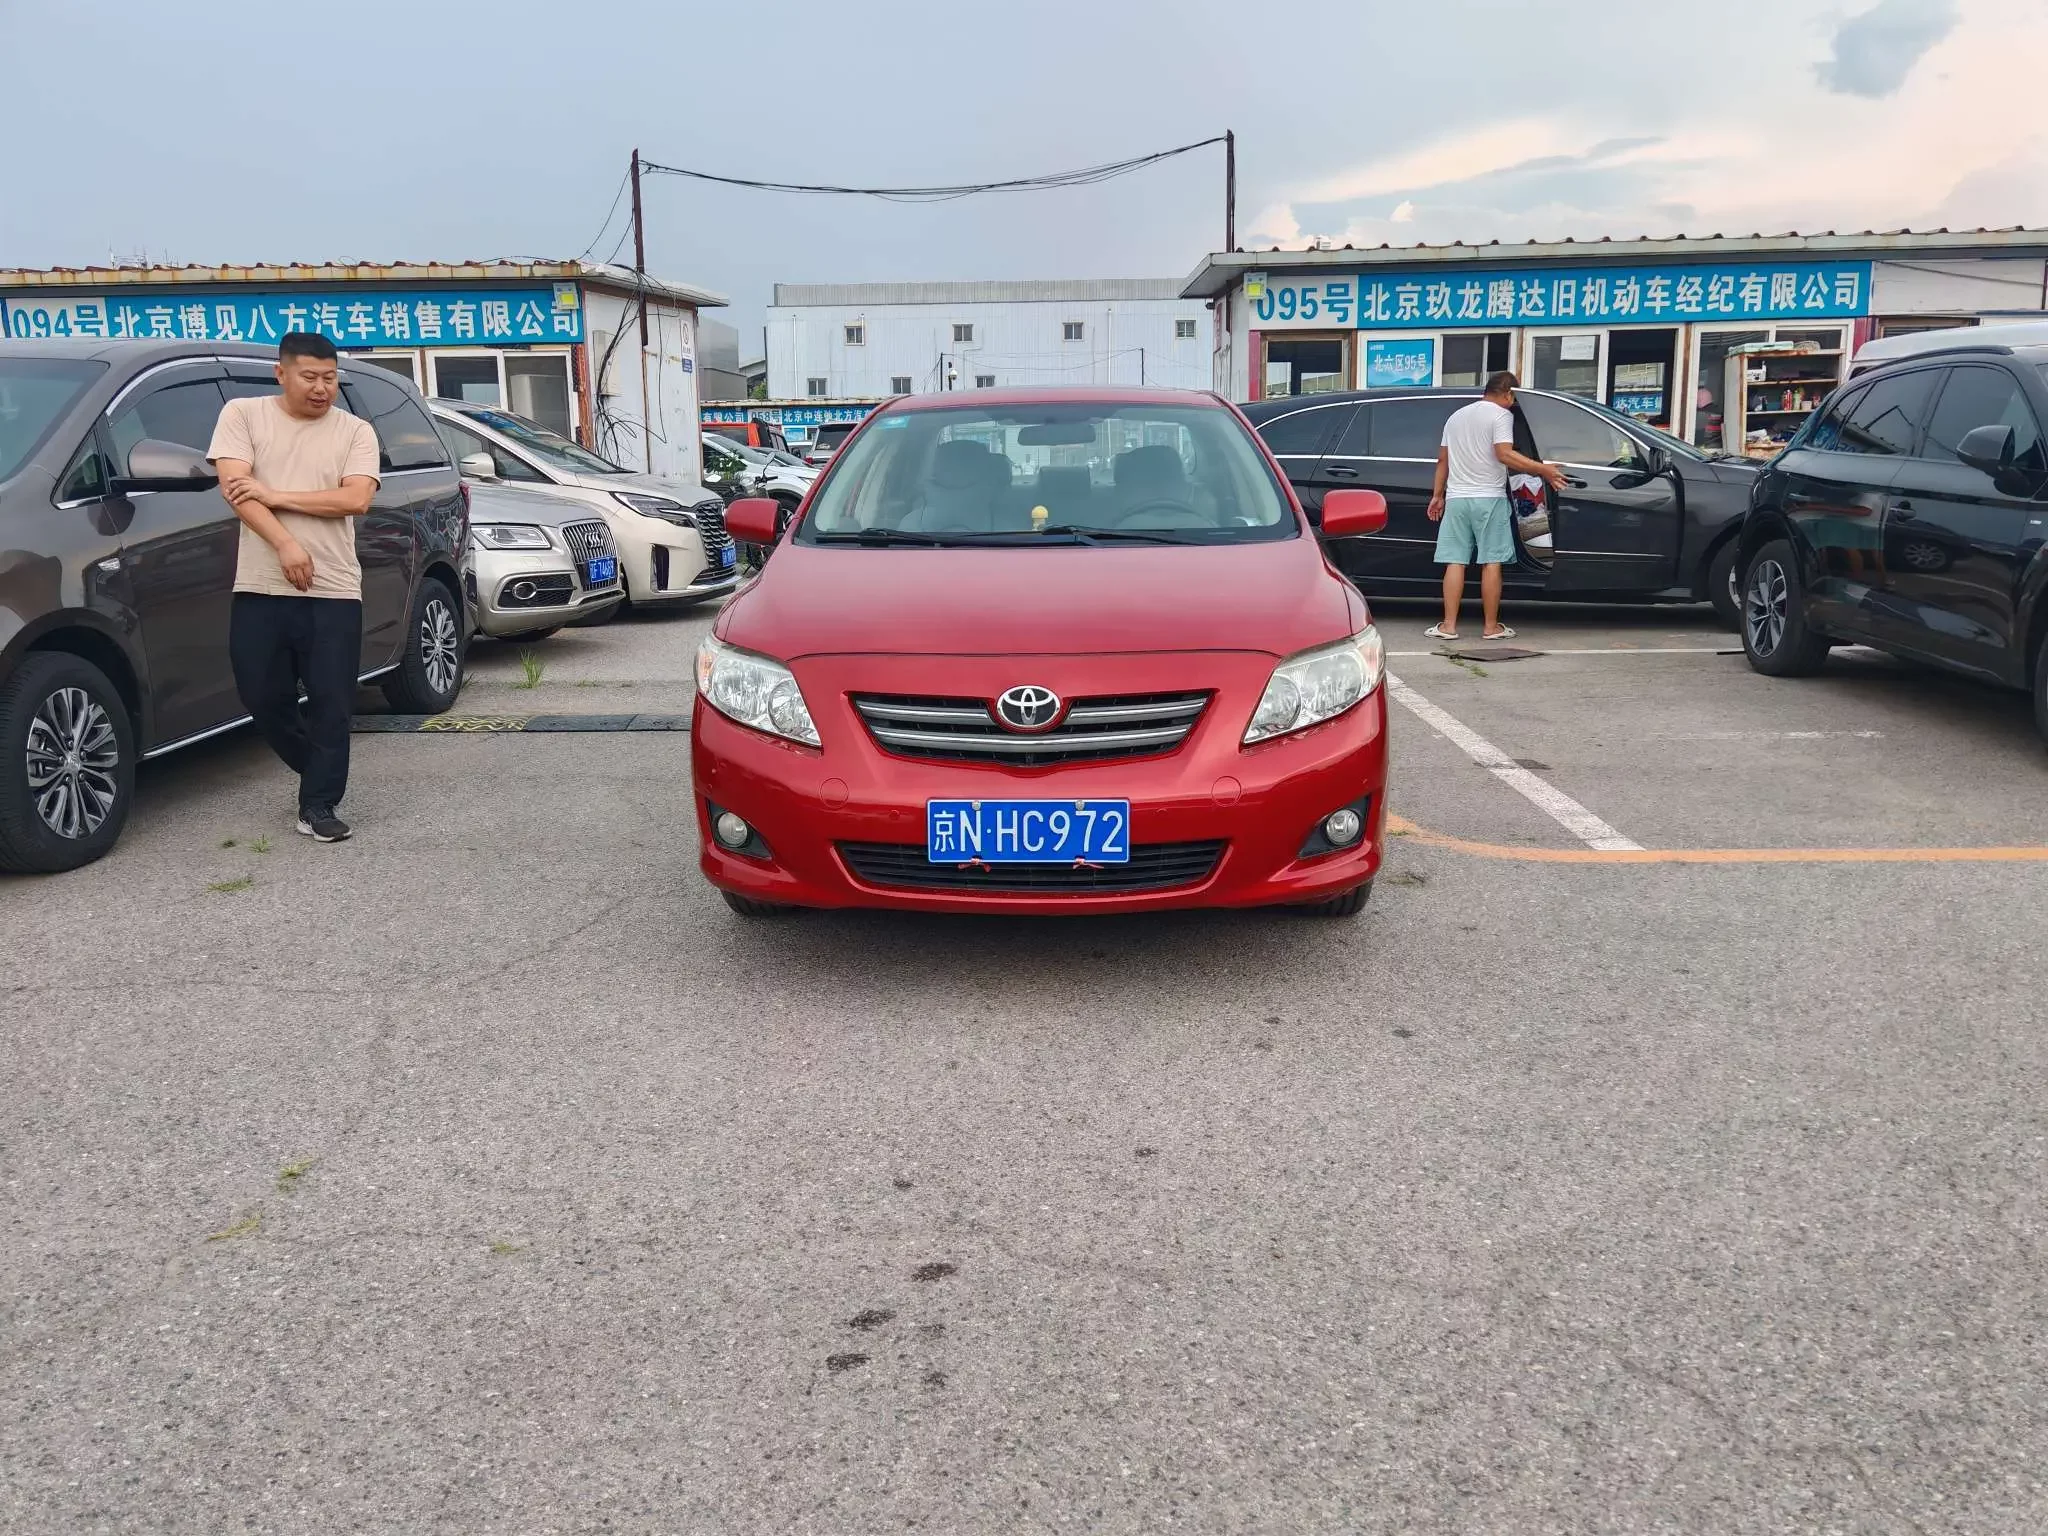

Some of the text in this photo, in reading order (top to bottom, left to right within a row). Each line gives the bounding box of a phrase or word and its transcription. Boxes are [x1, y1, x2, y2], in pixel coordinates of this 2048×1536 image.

[1257, 271, 1860, 323] 095号 北京玖龙腾达旧机动车经纪有限公司
[13, 299, 580, 343] 094号 北京博见八方汽车销售有限公司
[1374, 353, 1426, 372] 北六区95号
[702, 411, 745, 423] 有限公司
[933, 809, 1124, 853] 京N·HC972
